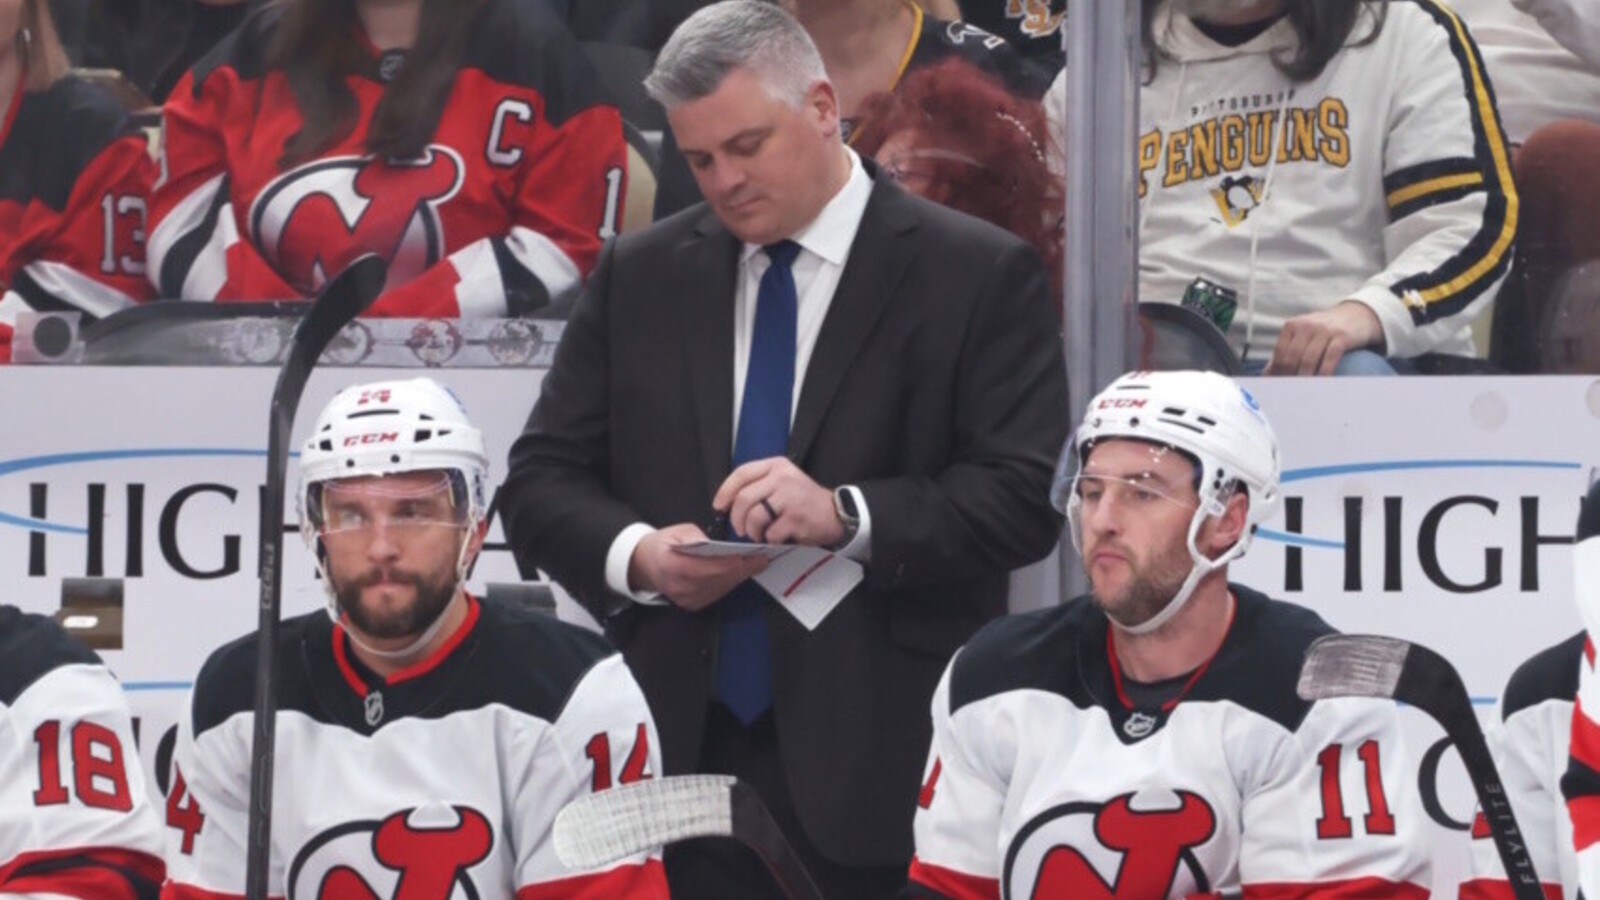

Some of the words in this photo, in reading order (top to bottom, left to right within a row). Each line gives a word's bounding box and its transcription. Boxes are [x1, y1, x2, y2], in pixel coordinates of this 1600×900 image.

[486, 98, 533, 167] C
[1139, 96, 1350, 199] PENGUINS
[100, 192, 147, 275] 13
[343, 432, 398, 447] CCM
[33, 719, 134, 813] 18
[1316, 739, 1396, 840] 11
[1484, 782, 1536, 884] FLYLITE
